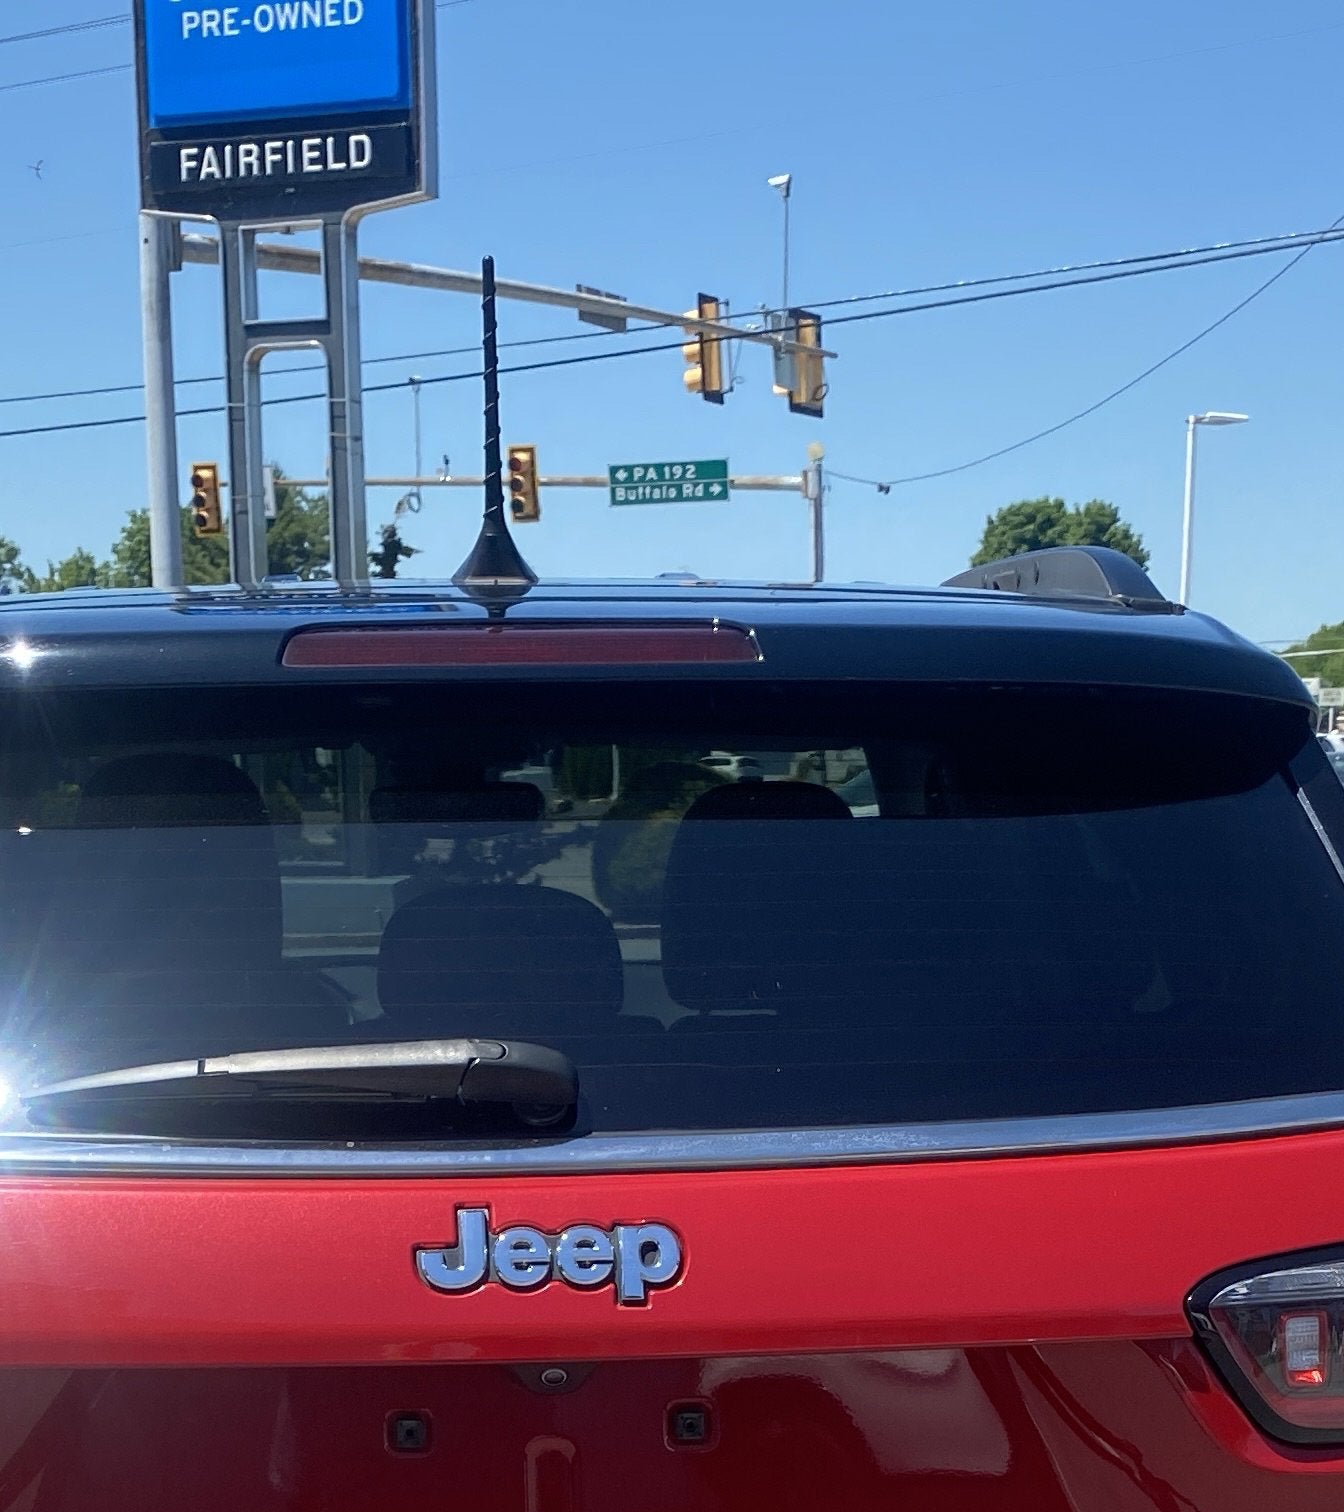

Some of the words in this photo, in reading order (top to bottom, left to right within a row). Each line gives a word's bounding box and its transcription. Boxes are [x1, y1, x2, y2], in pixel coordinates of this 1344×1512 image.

[182, 0, 364, 40] PRE-OWNED
[179, 134, 373, 182] FAIRFIELD
[616, 485, 677, 501] Buffalo
[682, 483, 705, 498] Rd
[632, 466, 658, 481] PA
[663, 464, 697, 480] 192
[413, 1204, 681, 1302] Jeep
